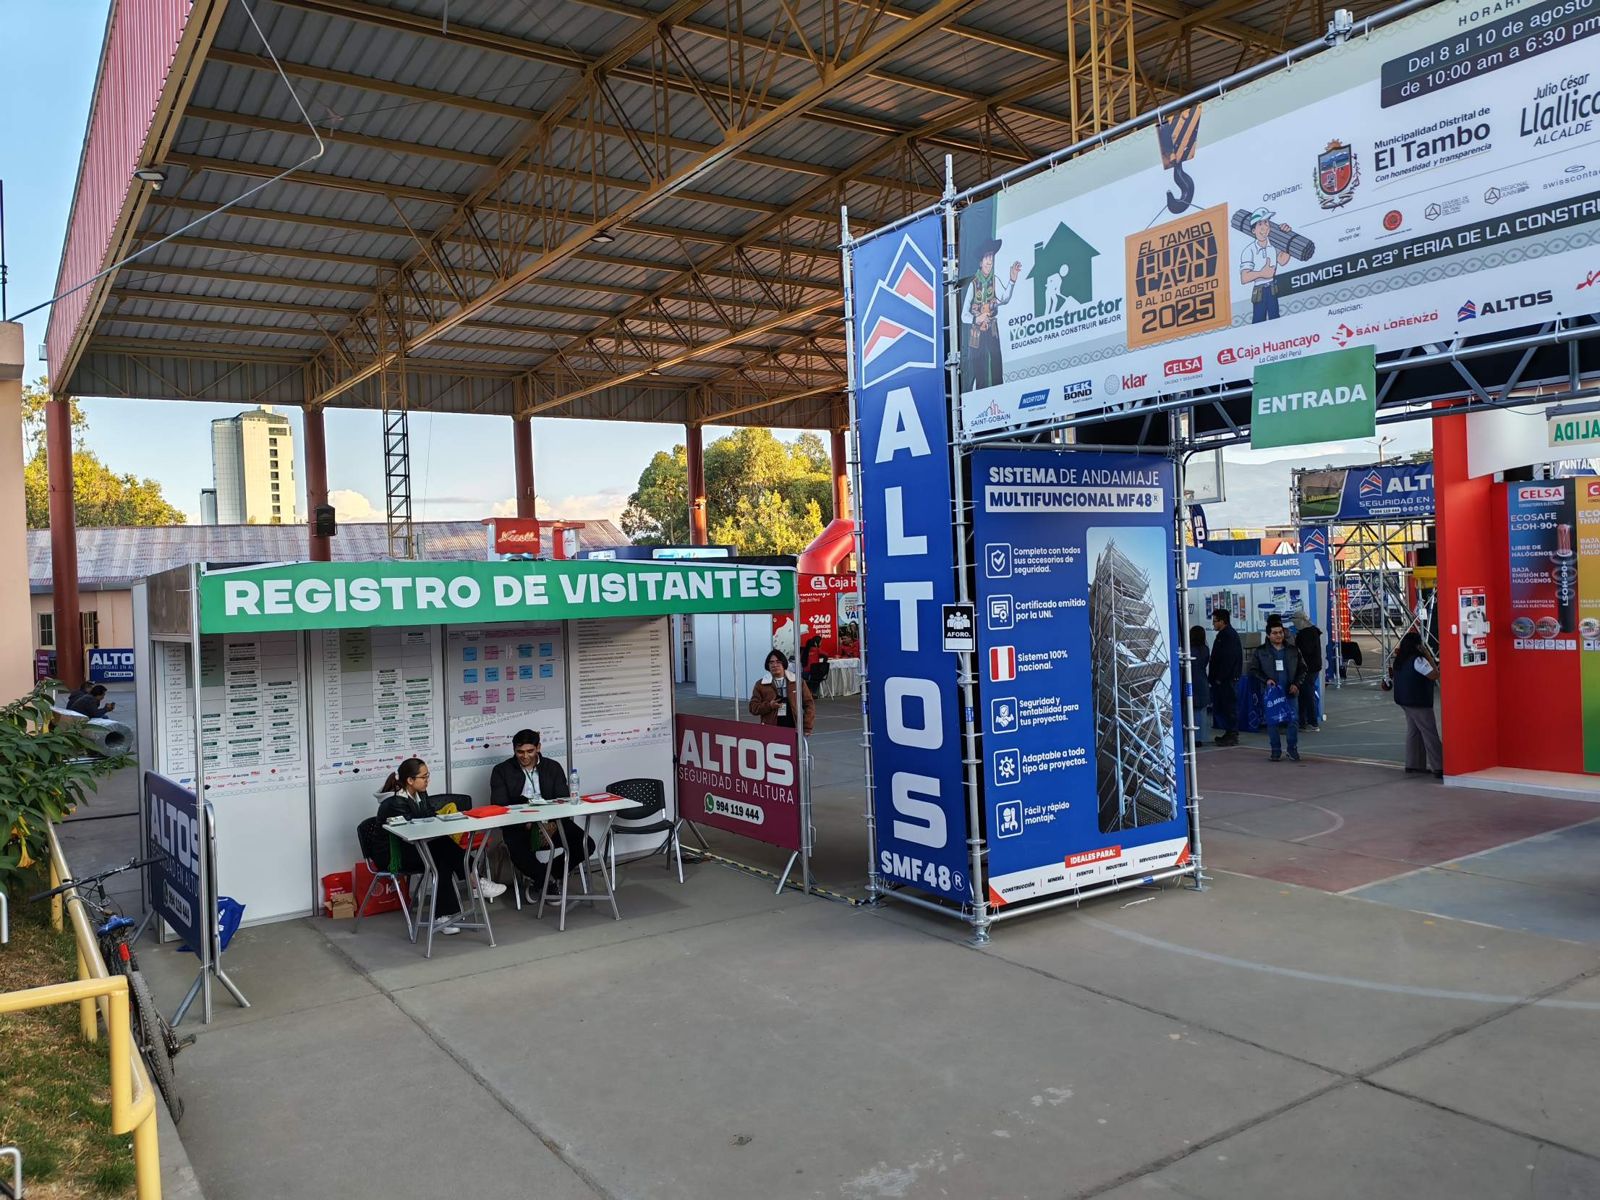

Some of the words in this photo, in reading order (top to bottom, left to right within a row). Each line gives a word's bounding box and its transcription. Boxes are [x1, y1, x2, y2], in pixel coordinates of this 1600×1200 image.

[1408, 51, 1435, 73] Del
[1439, 46, 1450, 62] 8
[1455, 37, 1469, 56] al
[1476, 28, 1496, 47] 10
[1502, 21, 1524, 38] de
[1530, 0, 1592, 27] agosto
[1401, 80, 1420, 97] de
[1427, 61, 1471, 88] 10:00
[1476, 53, 1503, 70] am
[1509, 46, 1520, 59] a
[1525, 27, 1566, 53] 6:30
[1572, 15, 1600, 39] pm
[1533, 82, 1558, 101] Julio
[1560, 73, 1590, 92] César
[1374, 123, 1438, 150] Municipalidad
[1439, 110, 1476, 134] Distrital
[1478, 106, 1491, 119] de
[1533, 119, 1593, 147] ALCALDE
[1374, 148, 1395, 172] El
[1401, 123, 1491, 163] Tambo
[1375, 174, 1390, 183] Con
[1390, 160, 1431, 180] honestidad
[1433, 159, 1439, 168] y
[1439, 143, 1492, 166] transparencia
[1543, 169, 1600, 190] swissconta
[1262, 183, 1303, 202] Organizan:
[1139, 240, 1156, 255] EL
[1159, 221, 1213, 246] TAMBO
[1290, 264, 1343, 289] SOMOS
[1347, 258, 1369, 273] LA
[1403, 236, 1453, 260] FERIA
[1457, 229, 1482, 246] DE
[1486, 222, 1511, 240] LA
[1135, 300, 1143, 310] 8
[1144, 296, 1158, 308] AL
[1160, 291, 1173, 303] 10
[1174, 278, 1219, 299] AGOSTO
[1327, 303, 1363, 317] Auspician:
[1480, 290, 1553, 316] ALTOS
[1008, 312, 1034, 327] expo
[1142, 291, 1215, 334] 2025
[1011, 336, 1043, 350] EDUCANDO
[1043, 331, 1060, 342] PARA
[1060, 320, 1097, 337] CONSTRUIR
[1098, 313, 1122, 326] MEJOR
[1356, 325, 1380, 336] SAN
[1384, 312, 1439, 330] LORENZO
[1237, 345, 1261, 361] Caja
[1263, 333, 1320, 353] Huancayo
[1268, 354, 1279, 362] Caja
[1279, 352, 1288, 360] del
[1165, 359, 1200, 374] CELSA
[1065, 381, 1092, 393] TEK
[1122, 373, 1148, 390] klar
[1022, 394, 1046, 404] NORTON
[1064, 388, 1093, 400] BOND
[1257, 383, 1368, 415] ENTRADA
[970, 413, 1011, 427] SAINT-GOBAIN
[989, 466, 1057, 485] SISTEMA
[1060, 468, 1077, 484] DE
[1081, 469, 1160, 486] ANDAMIAJE
[989, 492, 1114, 507] MULTIFUNCIONAL
[1416, 496, 1430, 504] EN
[1520, 488, 1562, 500] CELSA
[1511, 511, 1557, 522] ECOSAFE
[1013, 547, 1047, 557] Completo
[1062, 547, 1081, 555] todos
[1027, 556, 1064, 565] accesorios
[1014, 565, 1052, 576] seguridad.
[1234, 559, 1266, 568] ADHESIVOS
[1270, 558, 1299, 567] SELLANTES
[1233, 570, 1260, 580] ADITIVOS
[1265, 568, 1300, 578] PEGAMENTOS
[828, 577, 849, 590] Caja
[224, 576, 481, 616] REGISTRO
[493, 575, 549, 606] DE
[559, 569, 782, 605] VISITANTES
[1015, 600, 1057, 610] Certificado
[1058, 599, 1086, 608] emitido
[809, 614, 831, 624] +240
[875, 386, 948, 850] ALTOS
[1016, 613, 1029, 622] por
[1030, 611, 1037, 620] la
[1038, 610, 1054, 620] UNI.
[91, 653, 134, 665] ALTO
[1018, 652, 1049, 662] Sistema
[1049, 650, 1068, 660] 100%
[1018, 662, 1054, 672] nacional.
[1019, 697, 1055, 709] Seguridad
[1020, 705, 1062, 717] rentabilidad
[1063, 704, 1079, 714] para
[1020, 718, 1032, 726] tus
[1032, 715, 1069, 727] proyectos.
[680, 729, 794, 787] ALTOS
[1022, 750, 1062, 766] Adaptable
[1068, 747, 1085, 757] todo
[1022, 764, 1038, 775] tipo
[1038, 762, 1048, 771] de
[1049, 756, 1088, 771] proyectos.
[679, 766, 732, 791] SEGURIDAD
[736, 778, 748, 795] EN
[752, 782, 794, 805] ALTURA
[716, 799, 729, 813] 994
[730, 802, 744, 817] 119
[745, 806, 760, 821] 444
[1024, 804, 1042, 816] Fácil
[1047, 800, 1070, 814] rápido
[1025, 813, 1056, 826] montaje.
[151, 793, 199, 875] ALTOS
[1070, 850, 1096, 865] IDEALES
[1096, 847, 1116, 860] PARA:
[1001, 882, 1035, 894] CONSTRUCCIÓN
[1047, 874, 1065, 884] MINERÍA
[1076, 869, 1094, 878] EVENTOS
[1105, 862, 1128, 871] INDUSTRIAS
